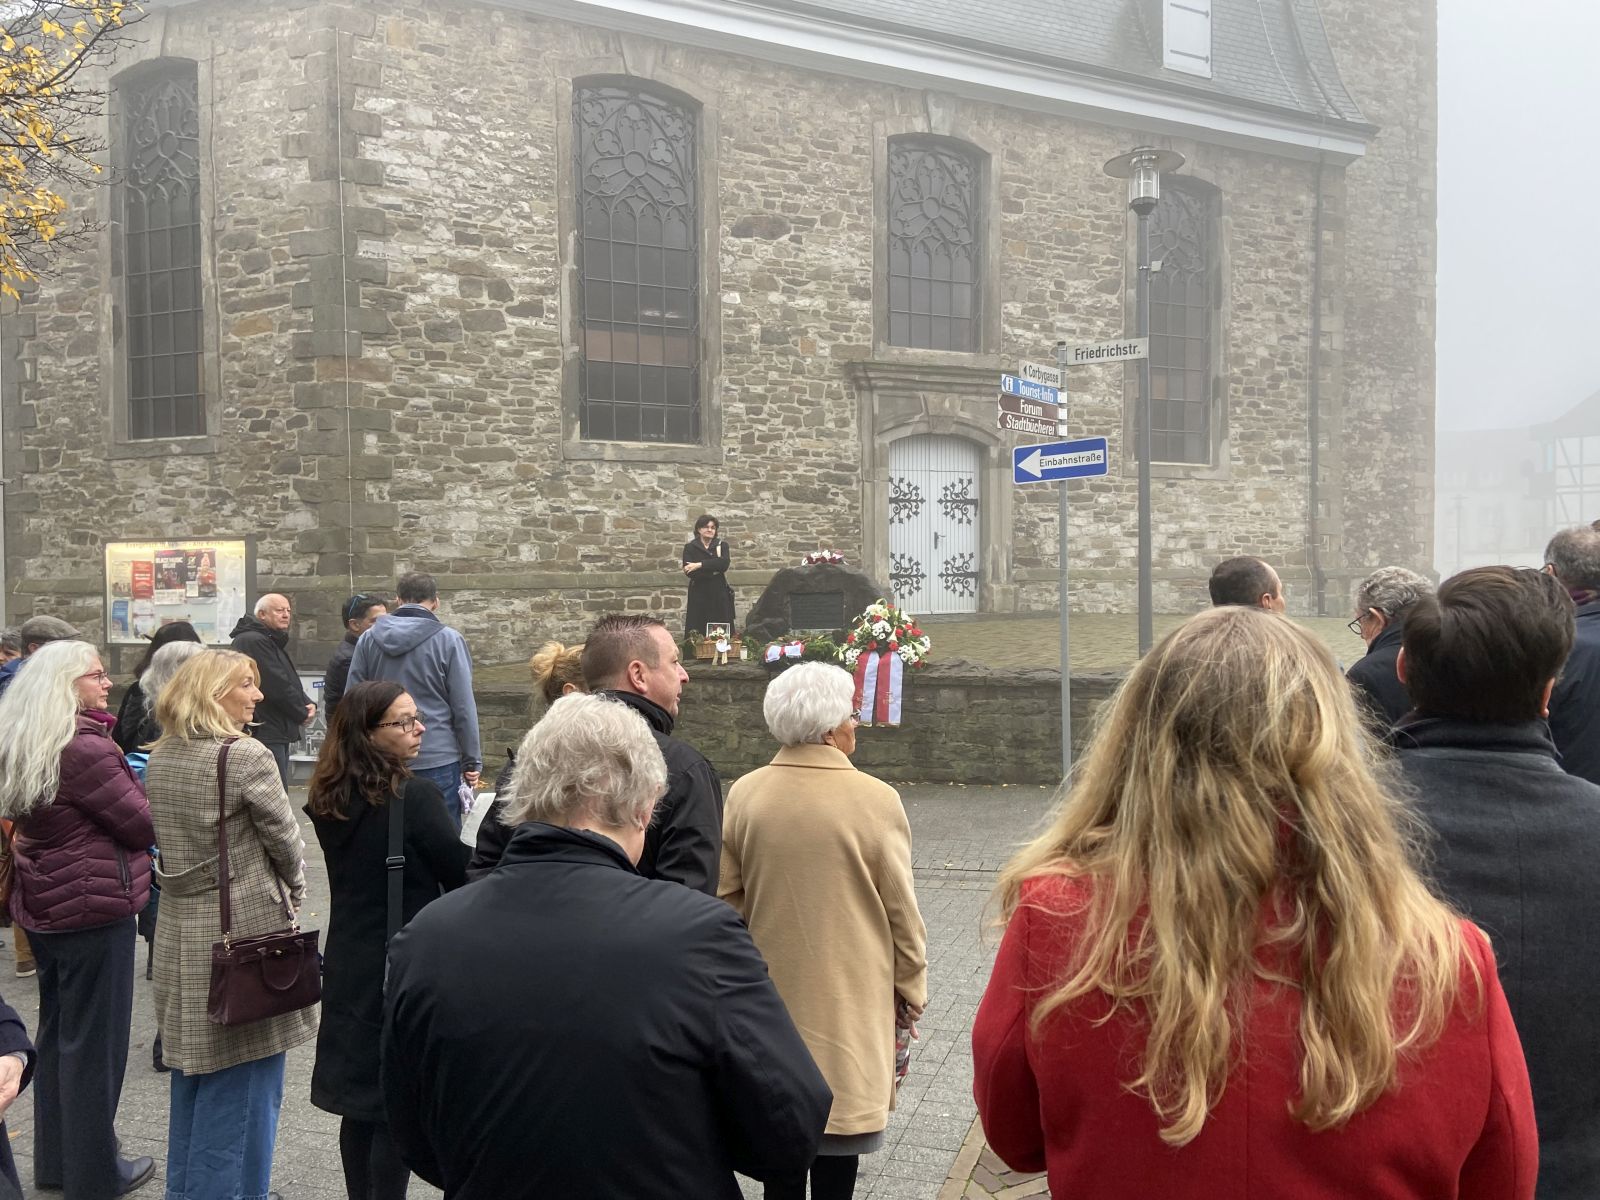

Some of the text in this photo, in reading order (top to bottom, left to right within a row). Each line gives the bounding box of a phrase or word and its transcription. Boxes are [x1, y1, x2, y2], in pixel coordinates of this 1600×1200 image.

[1075, 344, 1141, 361] Friedrichstr.
[1028, 365, 1059, 384] Corbygasse
[1018, 380, 1054, 403] Tourist-Info
[1020, 399, 1043, 417] Forum
[1006, 414, 1056, 436] Stadtbücherei
[1039, 453, 1102, 467] Einbahnstraße
